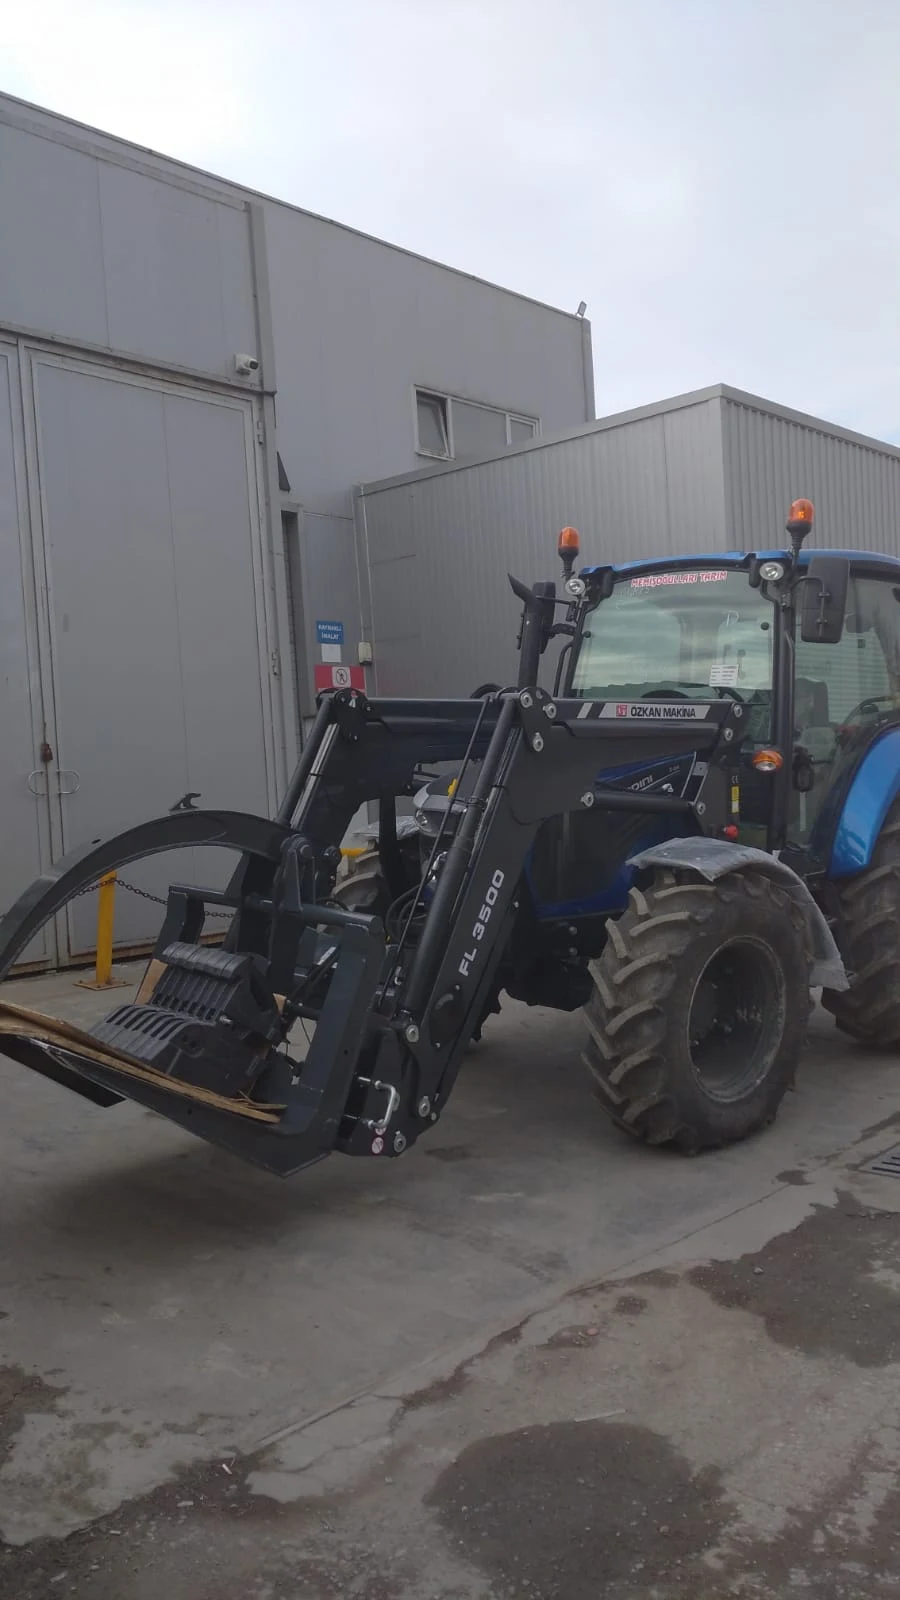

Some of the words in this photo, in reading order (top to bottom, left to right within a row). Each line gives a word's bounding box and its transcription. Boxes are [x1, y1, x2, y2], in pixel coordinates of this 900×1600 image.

[700, 570, 728, 583] TARIM
[458, 948, 477, 976] FL
[472, 869, 505, 941] 3500
